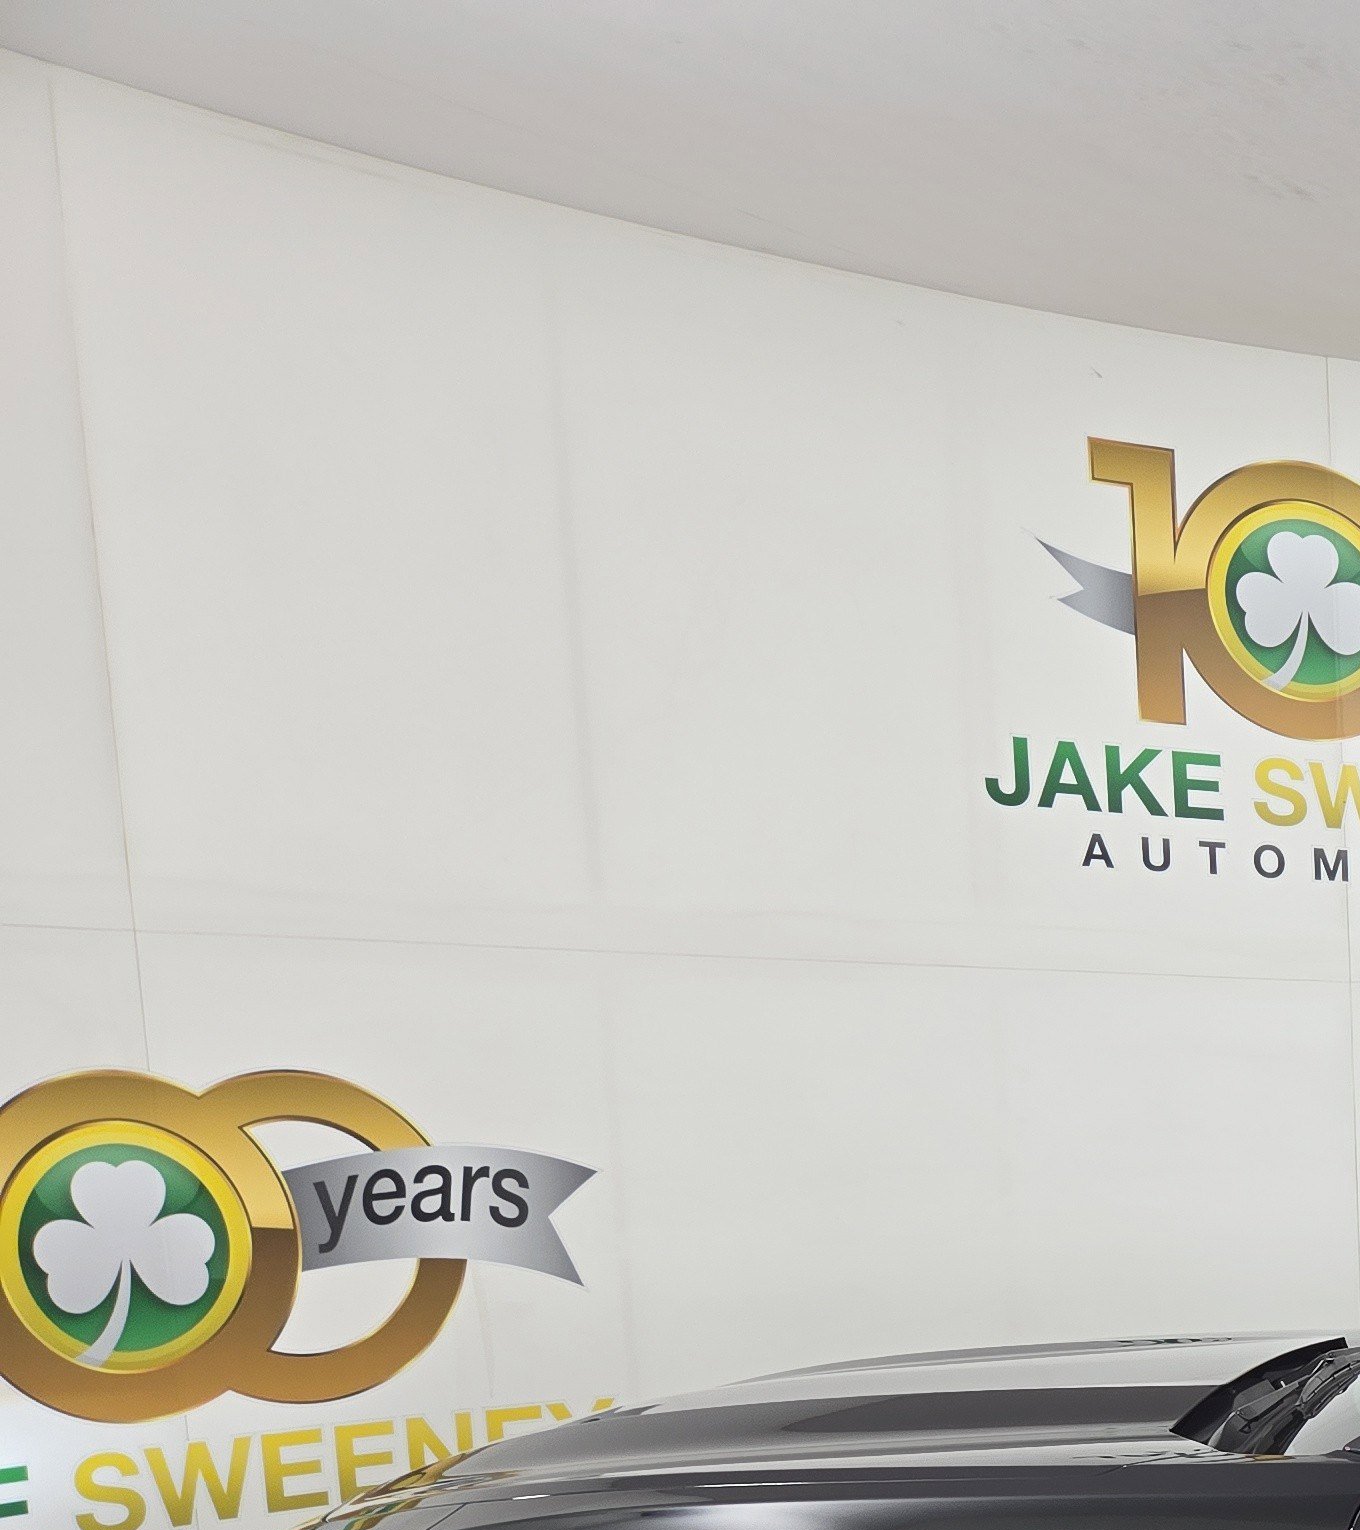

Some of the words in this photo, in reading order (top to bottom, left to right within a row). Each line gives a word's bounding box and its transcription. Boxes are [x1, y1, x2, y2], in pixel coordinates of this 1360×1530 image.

[985, 736, 1225, 821] JAKE
[0, 1069, 468, 1424] 00
[313, 1164, 530, 1254] years
